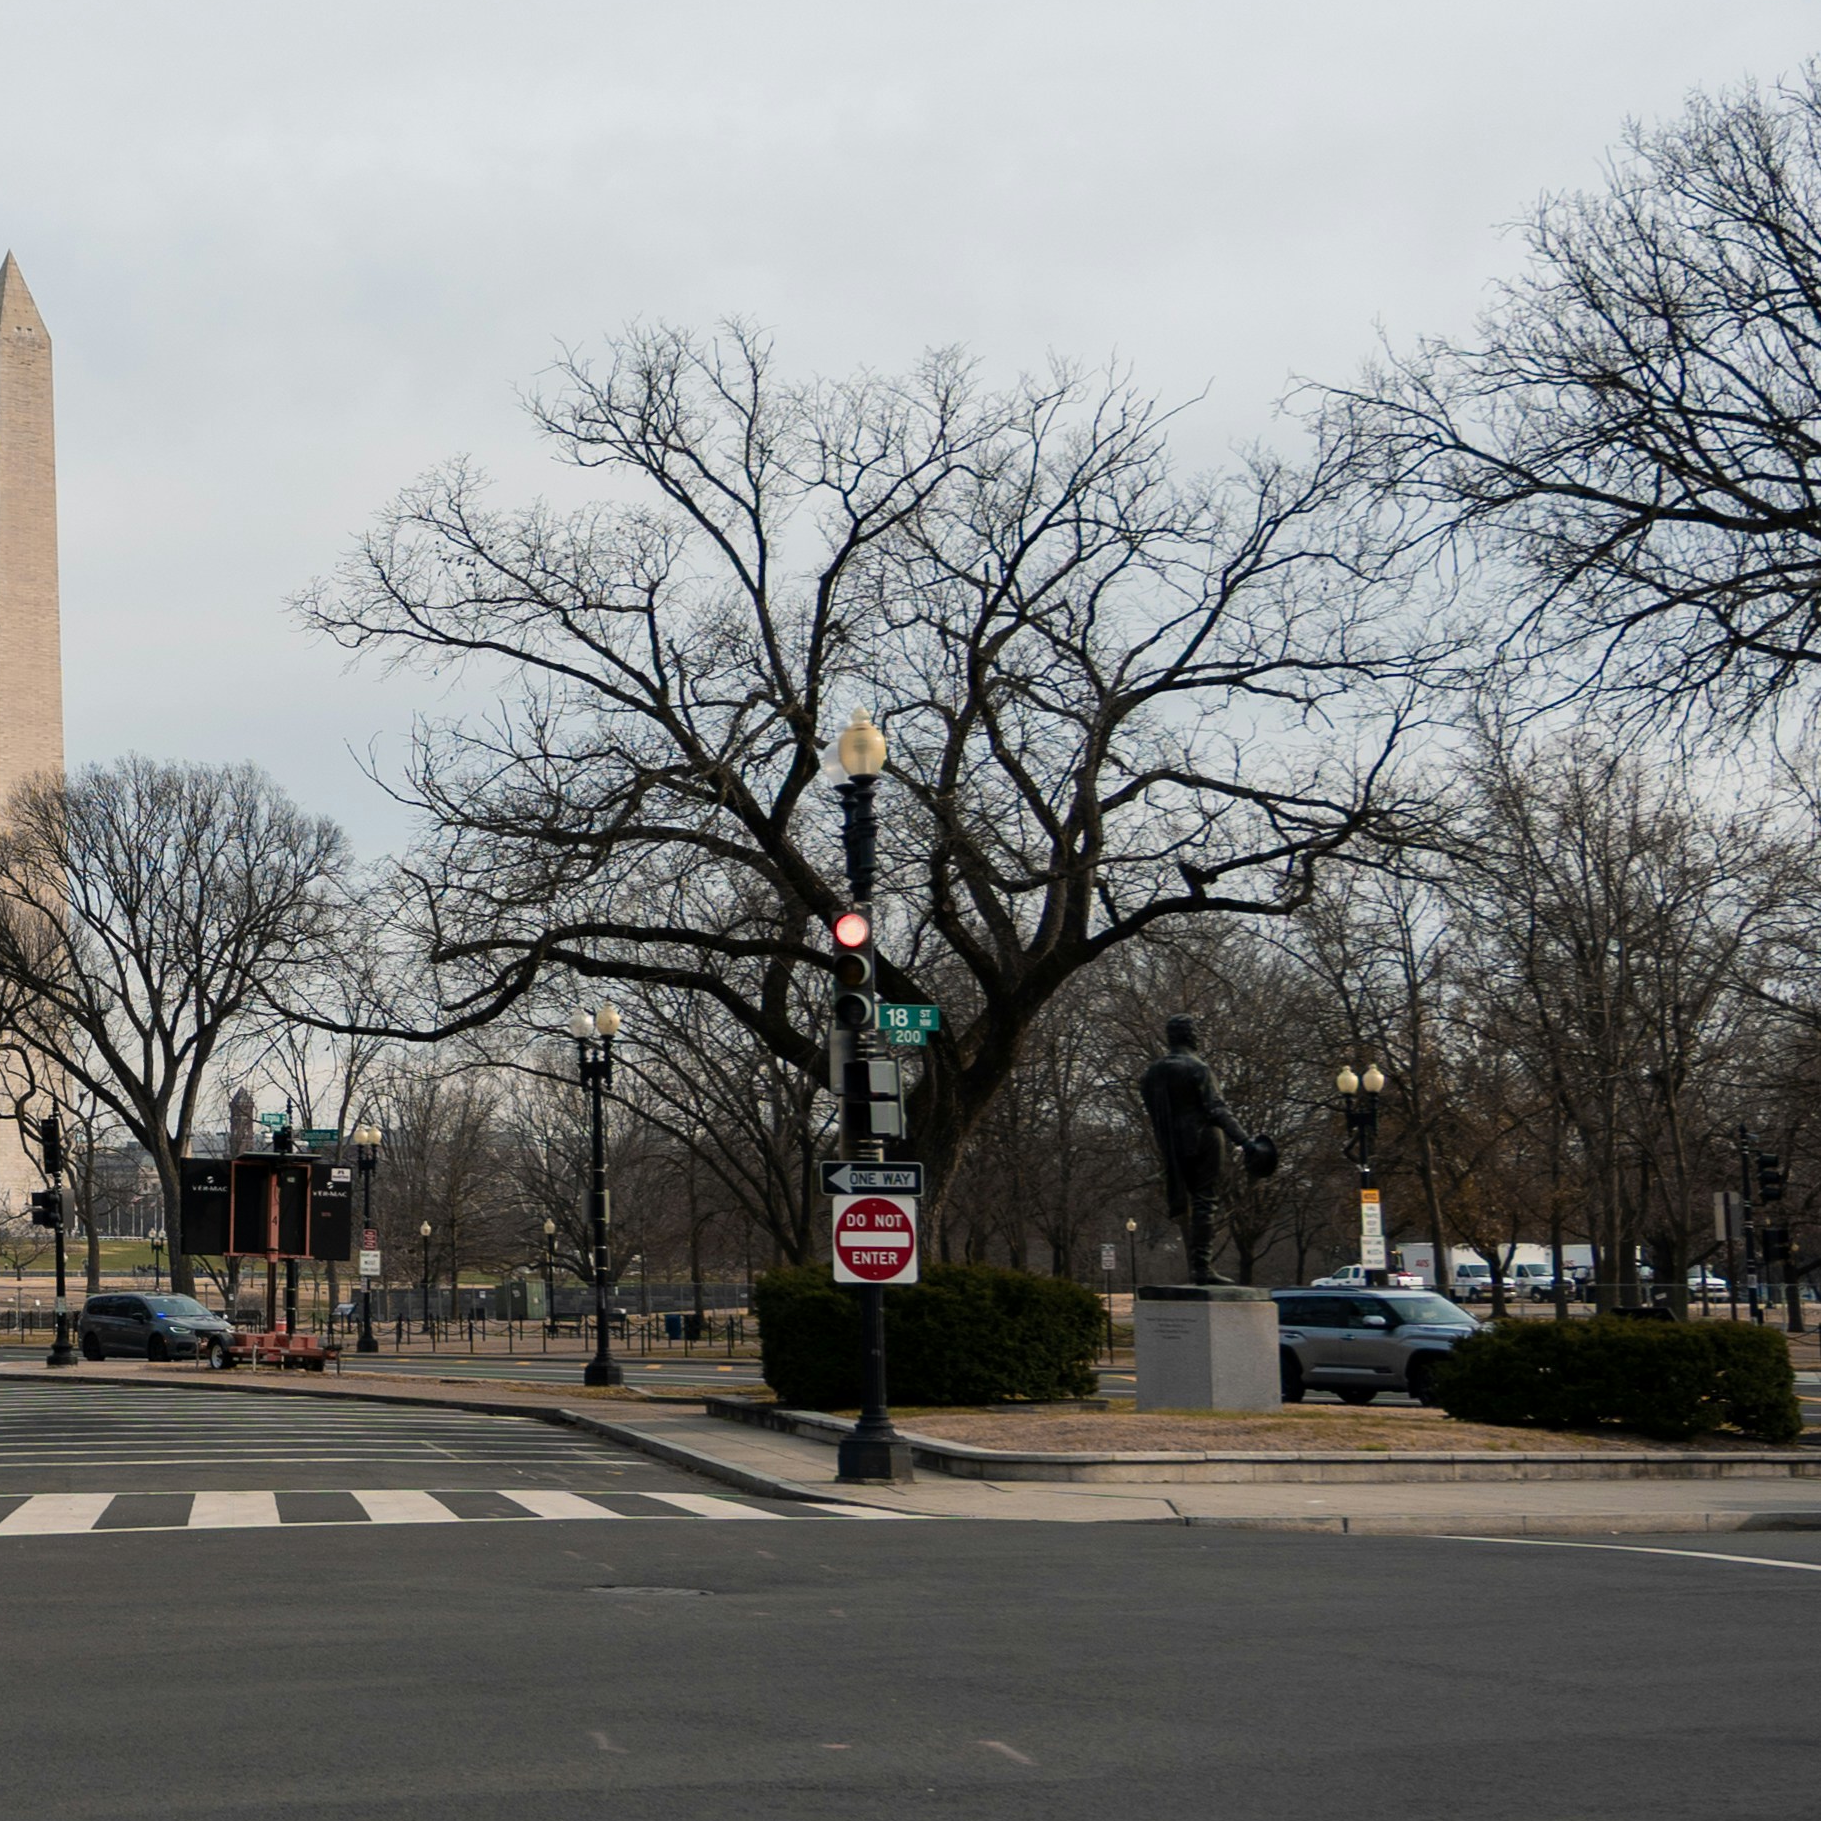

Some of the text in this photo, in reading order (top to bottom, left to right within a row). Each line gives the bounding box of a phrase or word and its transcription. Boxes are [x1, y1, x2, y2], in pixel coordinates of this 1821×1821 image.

[886, 1008, 931, 1027] 18 ST
[895, 1030, 921, 1043] 200
[849, 1172, 911, 1185] ONE WAY
[846, 1213, 903, 1228] DO NOT
[851, 1251, 898, 1265] ENTER
